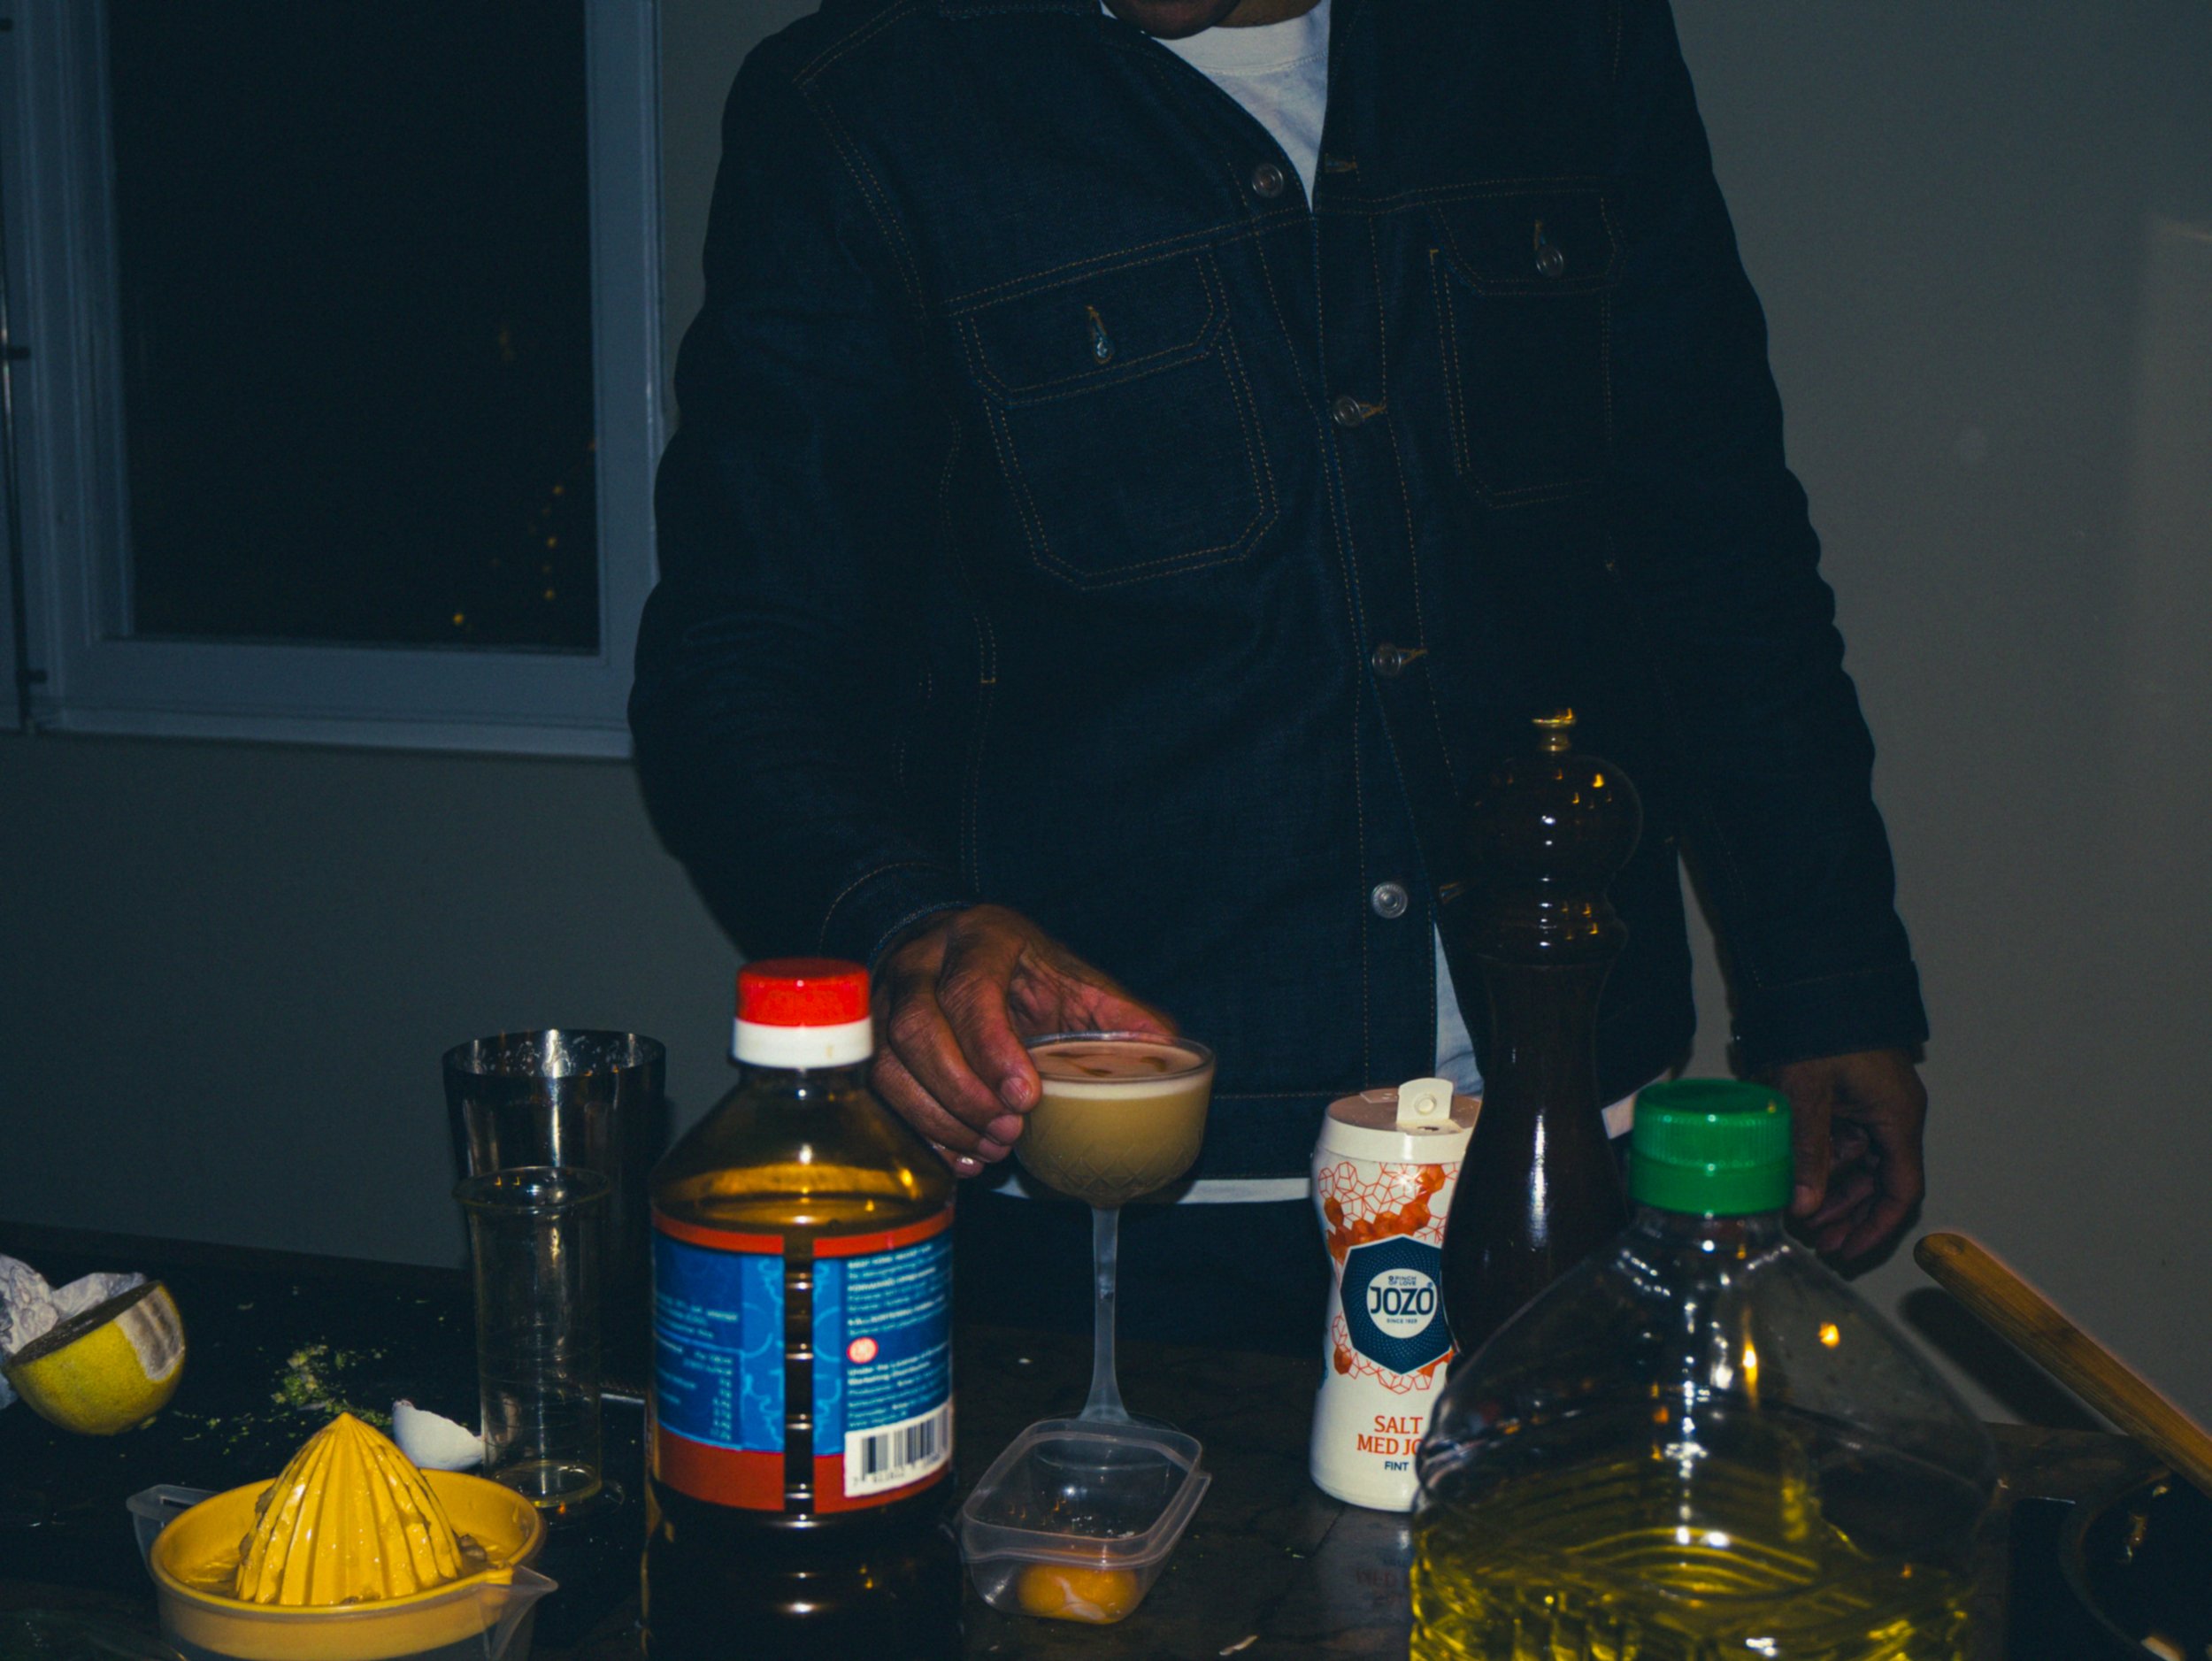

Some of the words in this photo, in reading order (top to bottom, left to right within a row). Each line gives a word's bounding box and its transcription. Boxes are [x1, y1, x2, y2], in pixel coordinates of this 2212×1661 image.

[1374, 1415, 1423, 1434] SALT
[1356, 1434, 1399, 1456] MED
[1384, 1460, 1409, 1471] FINT
